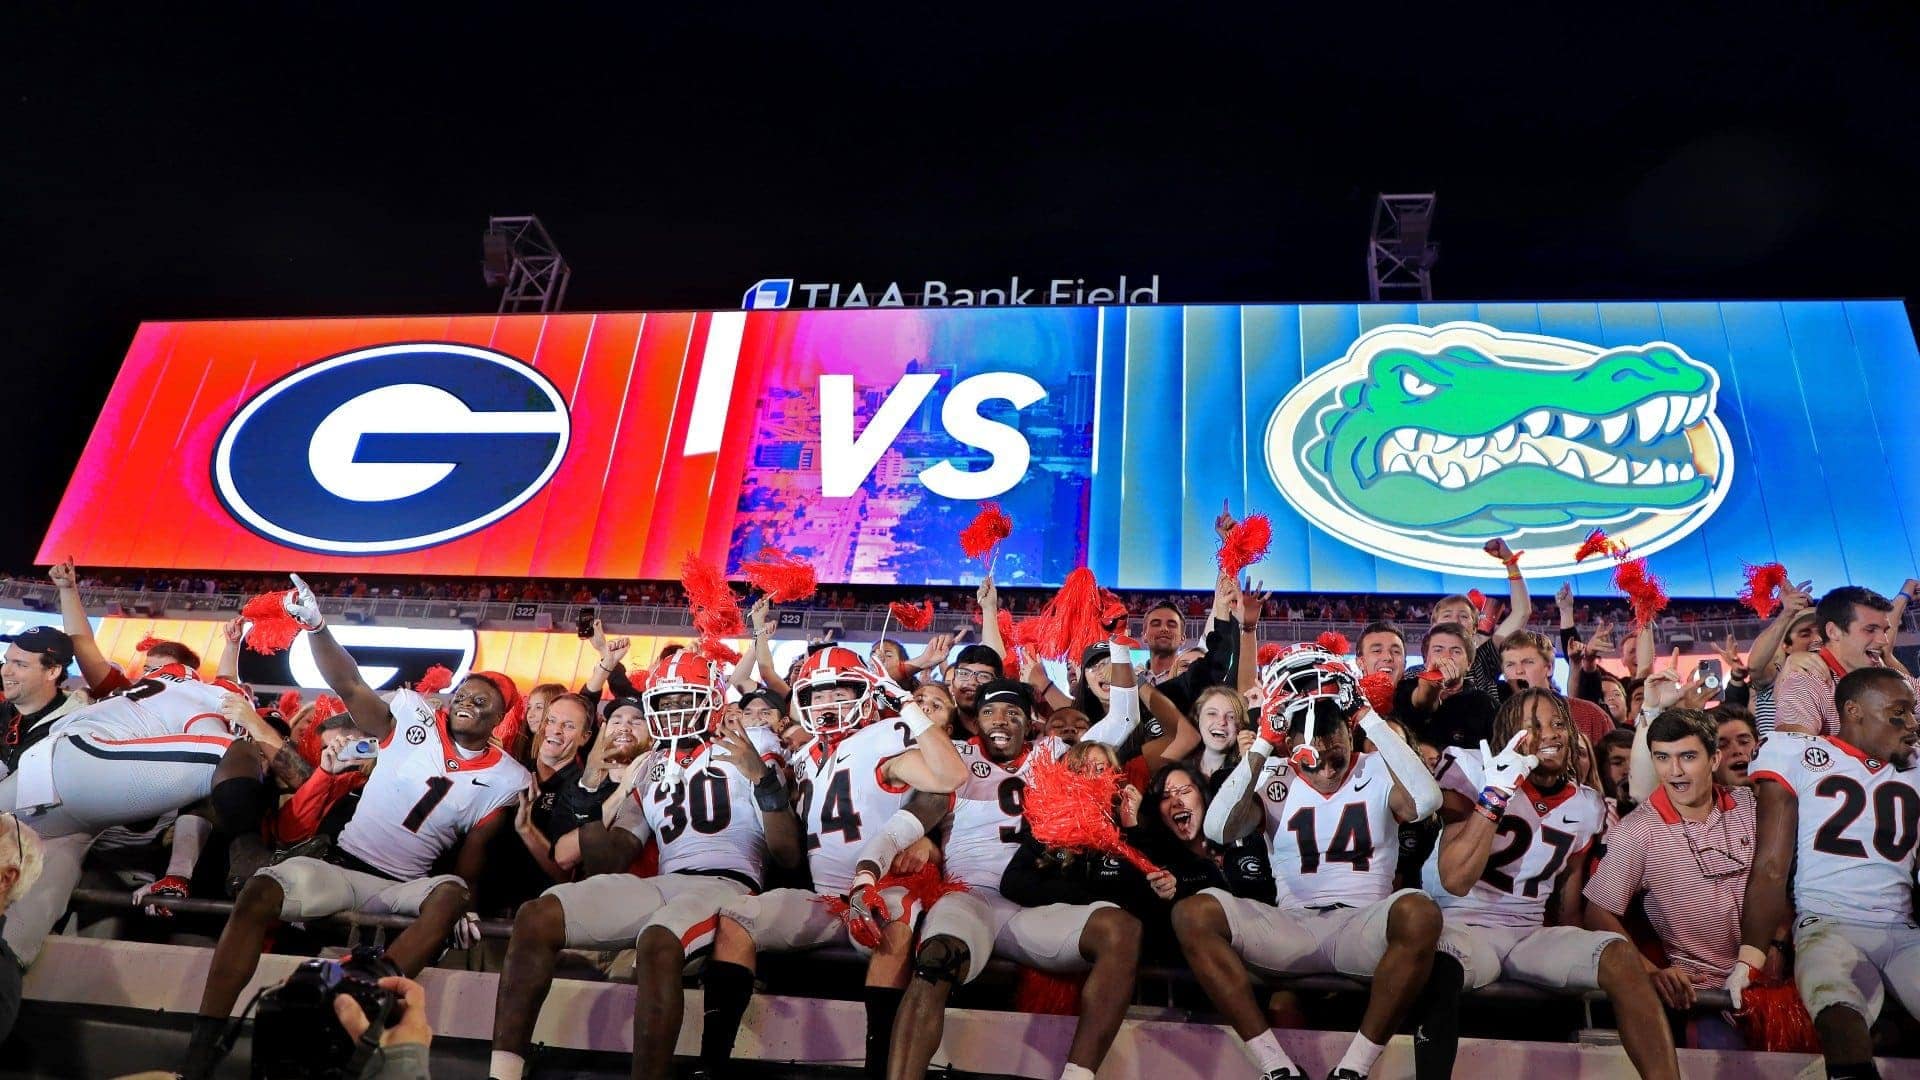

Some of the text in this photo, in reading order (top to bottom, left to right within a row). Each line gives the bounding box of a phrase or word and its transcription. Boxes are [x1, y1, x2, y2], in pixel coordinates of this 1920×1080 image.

[799, 275, 1160, 307] TIAA Bank Field
[818, 371, 1047, 500] VS
[515, 606, 535, 617] 322
[781, 614, 801, 624] 323
[971, 761, 991, 778] SEC
[1804, 747, 1829, 767] SEC
[402, 775, 455, 833] 1
[654, 766, 731, 845] 30
[1267, 781, 1288, 802] SEC
[1287, 800, 1375, 874] 14
[1813, 774, 1920, 863] 20
[1479, 814, 1577, 898] 27
